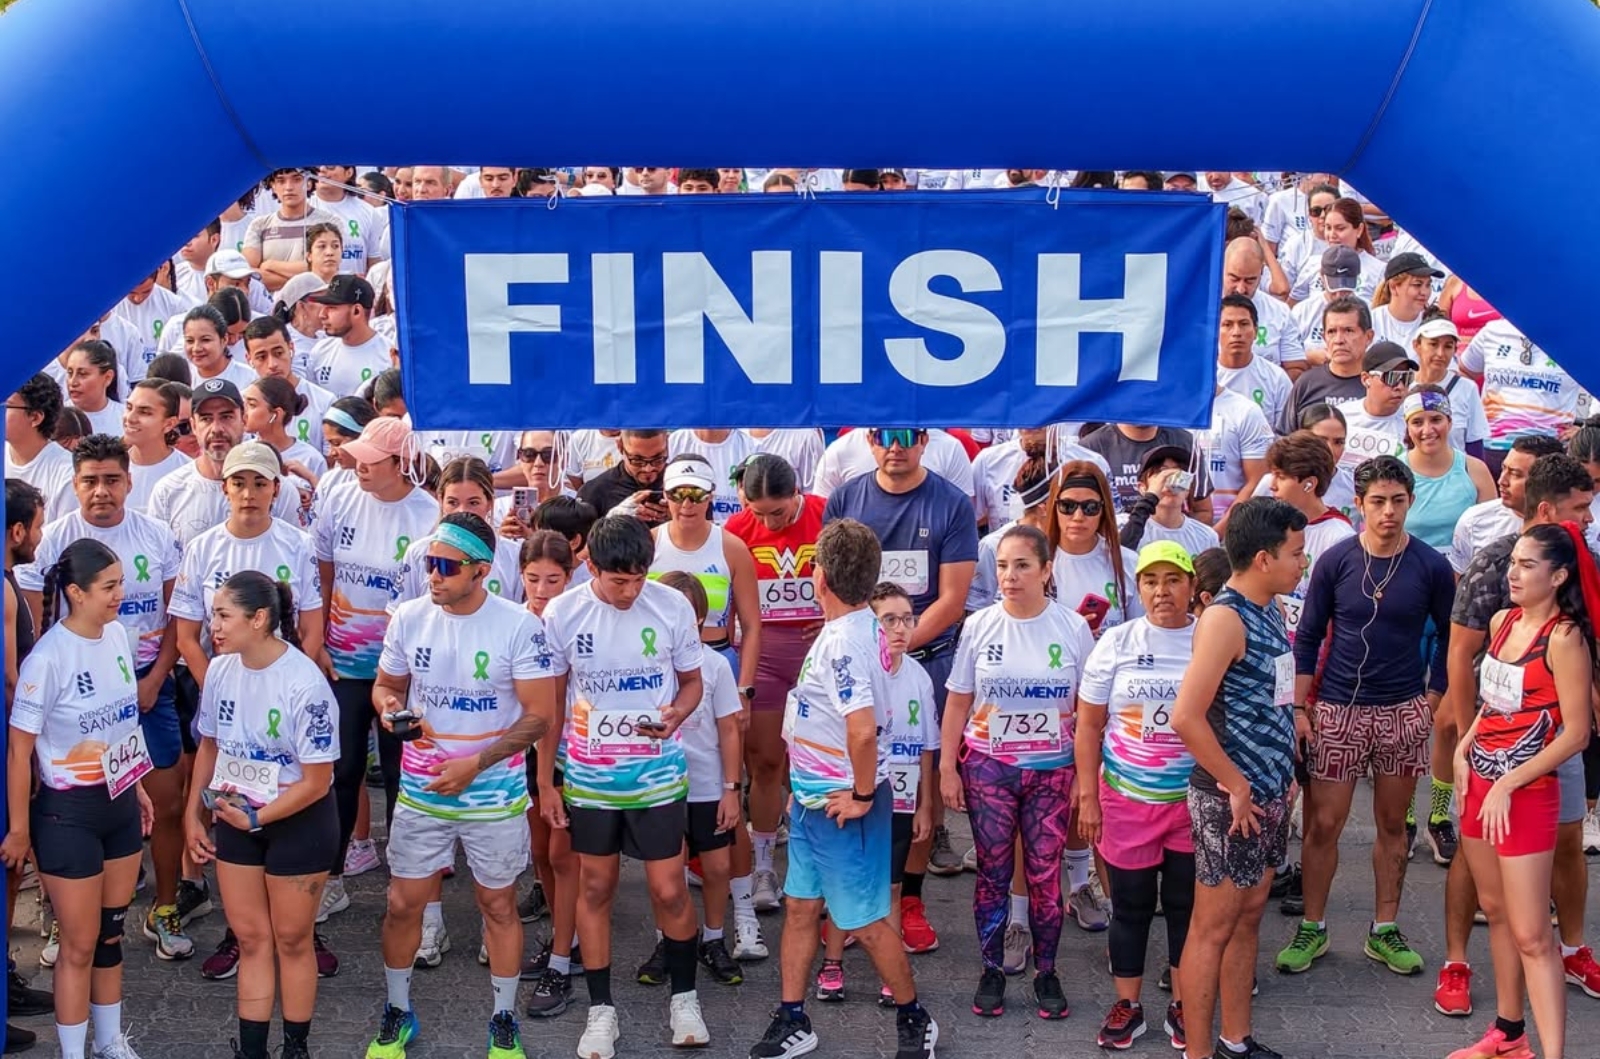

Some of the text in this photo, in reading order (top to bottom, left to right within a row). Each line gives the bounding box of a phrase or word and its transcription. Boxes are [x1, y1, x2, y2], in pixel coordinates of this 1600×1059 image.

[464, 249, 1168, 387] FINISH
[1349, 433, 1390, 454] 600
[766, 581, 815, 603] 650
[1020, 676, 1071, 685] PSIQUIÁTRICA
[1127, 678, 1173, 686] ATENCIÓN
[449, 687, 497, 697] PSIQUIÁTRICA
[981, 685, 1071, 699] SANAMENTE
[998, 713, 1050, 736] 732
[108, 735, 142, 775] 642
